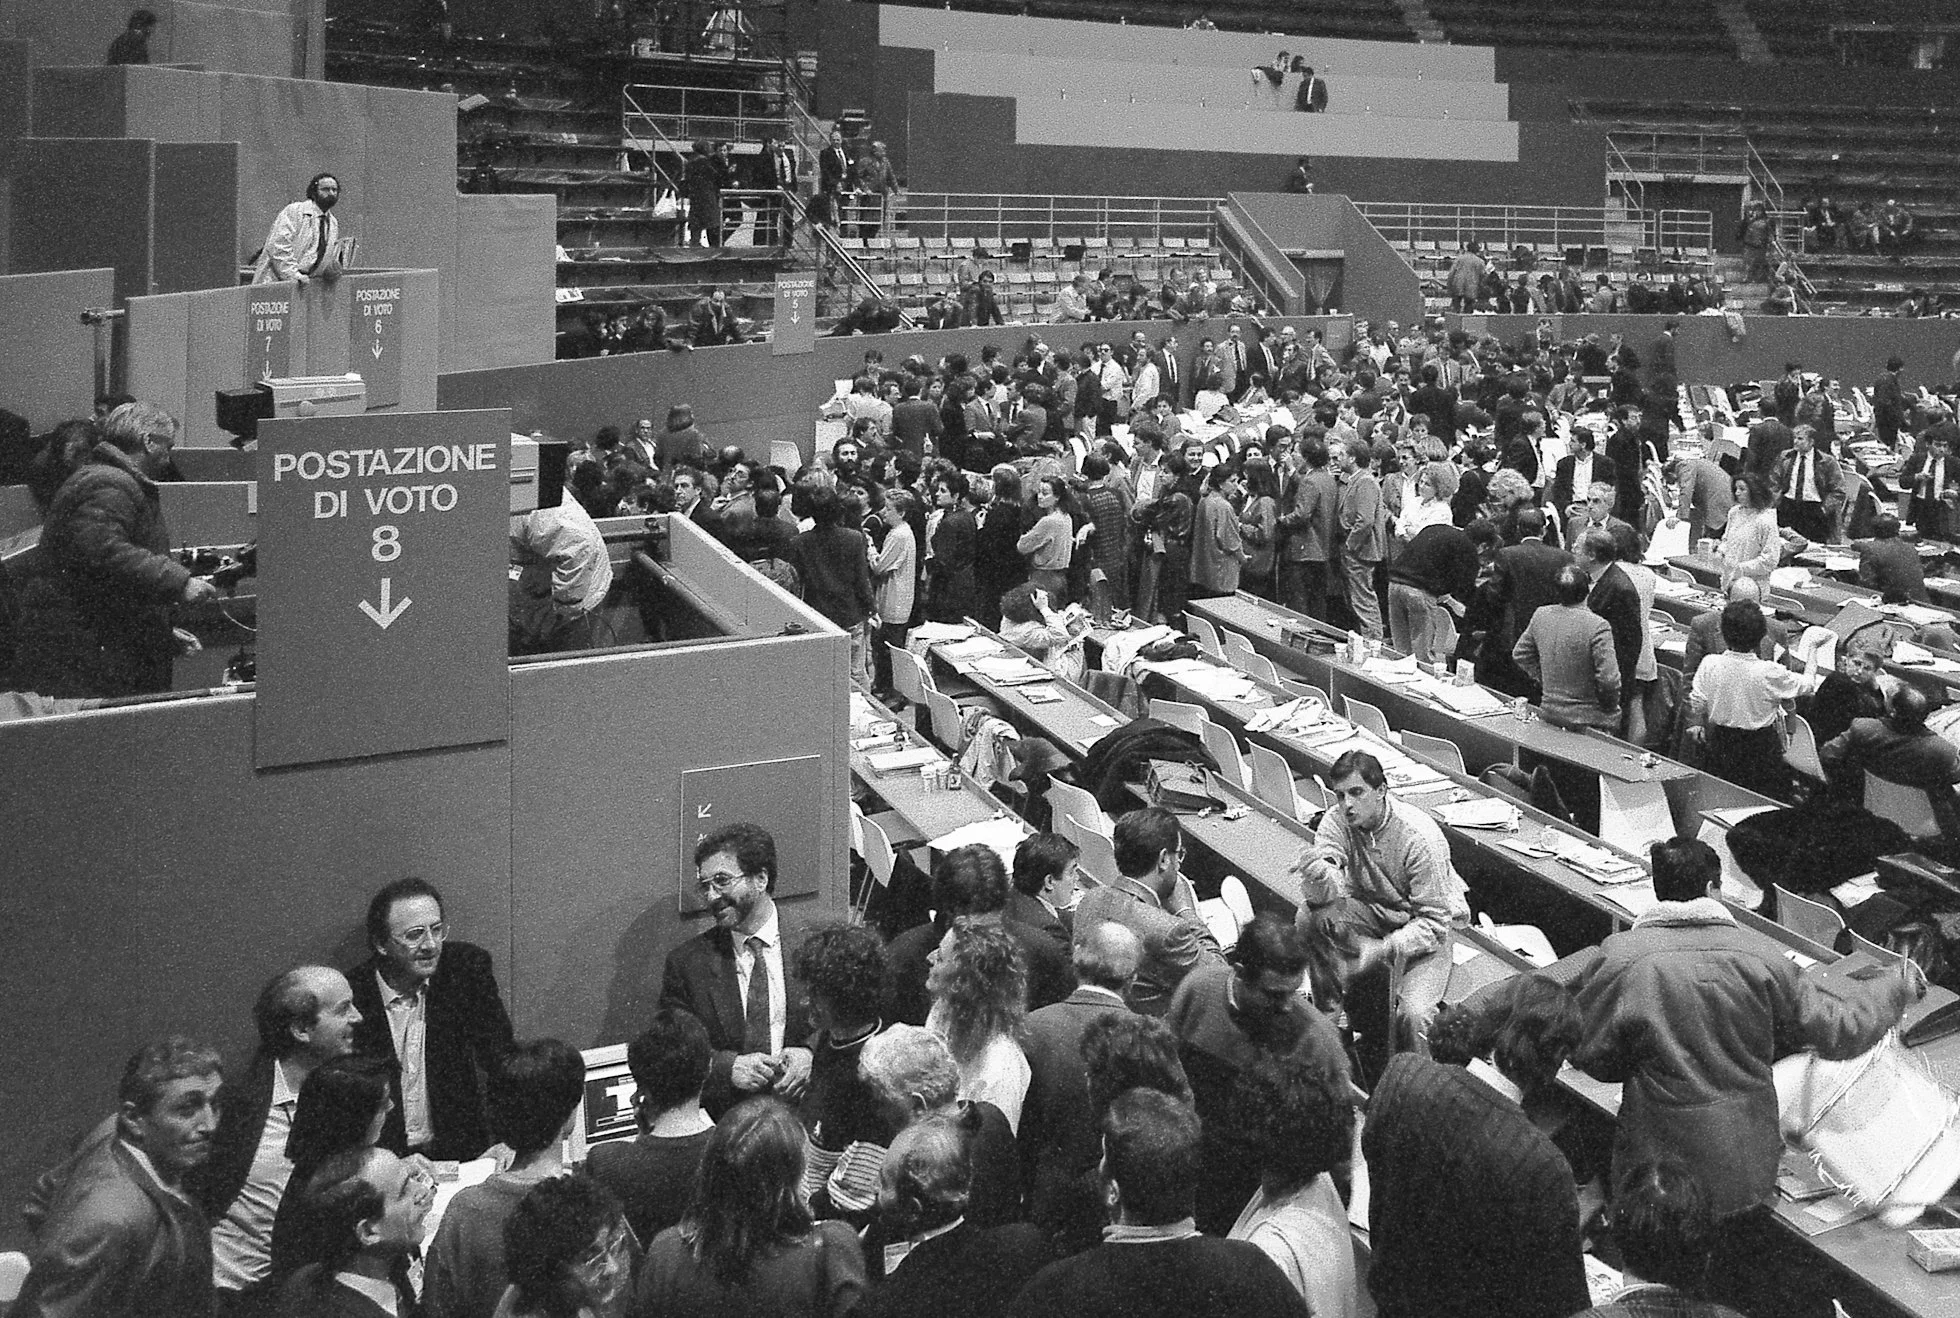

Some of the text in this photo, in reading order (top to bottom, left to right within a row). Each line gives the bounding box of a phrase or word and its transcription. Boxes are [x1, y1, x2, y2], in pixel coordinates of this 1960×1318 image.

[356, 288, 401, 301] POSTAZIONE
[251, 301, 289, 314] POSTAZIONE
[364, 303, 393, 316] DI VOTO
[792, 299, 799, 309] 5
[257, 318, 283, 331] DI VOTO
[375, 319, 382, 334] 6
[265, 336, 272, 352] 7
[274, 443, 497, 482] POSTAZIONE
[314, 484, 458, 519] DI VOTO
[371, 525, 402, 562] 8
